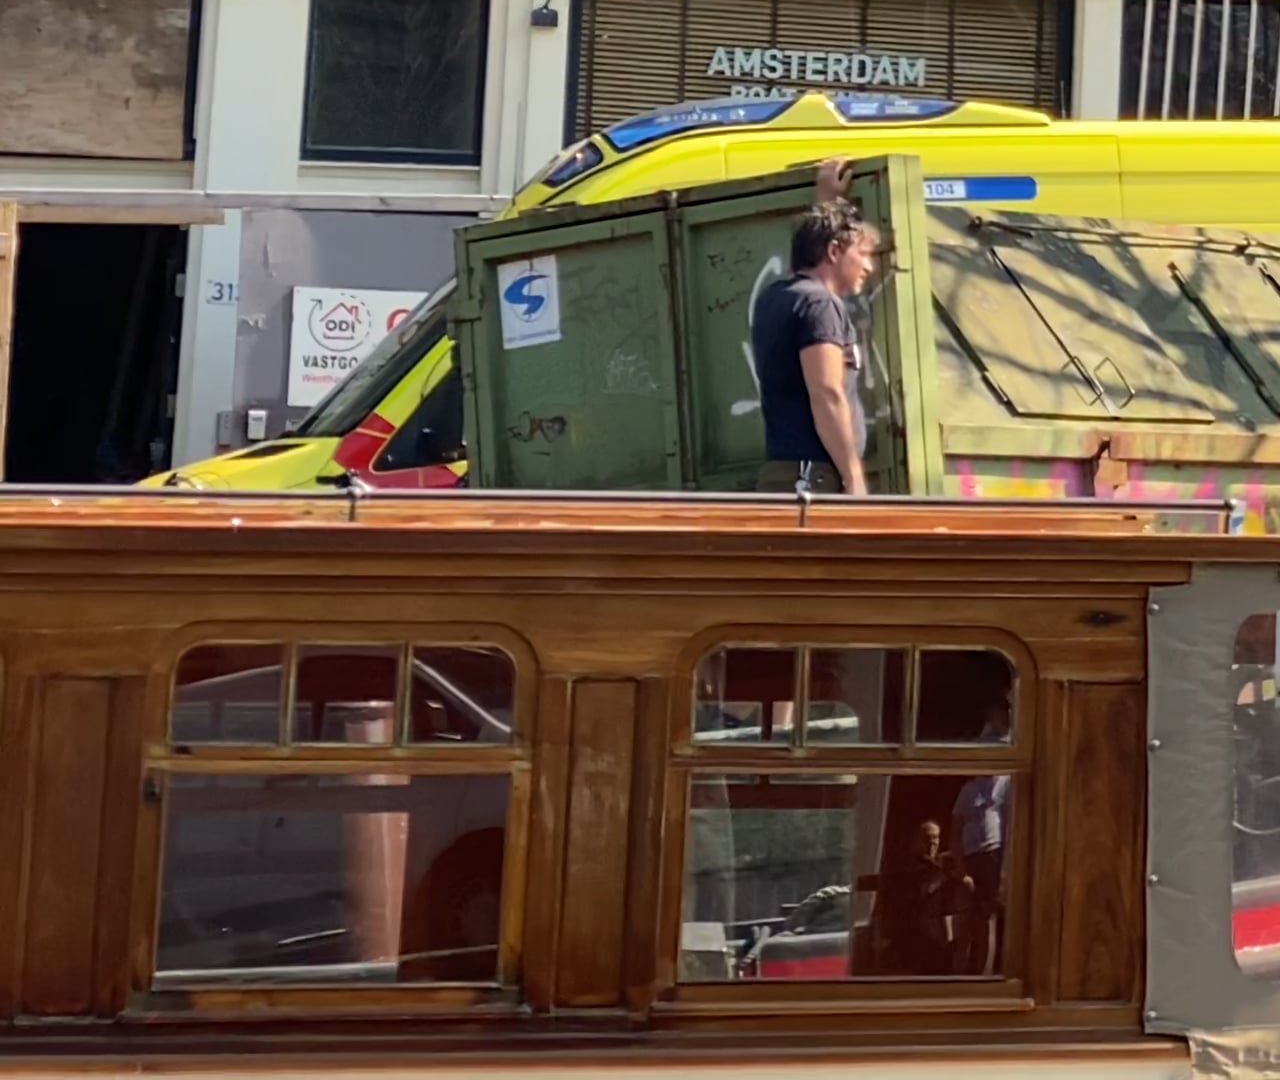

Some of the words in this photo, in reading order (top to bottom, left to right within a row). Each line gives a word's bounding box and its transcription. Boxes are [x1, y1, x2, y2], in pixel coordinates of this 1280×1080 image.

[706, 46, 926, 87] AMSTERDAM
[325, 320, 355, 333] ODI
[302, 354, 359, 370] VASTGO
